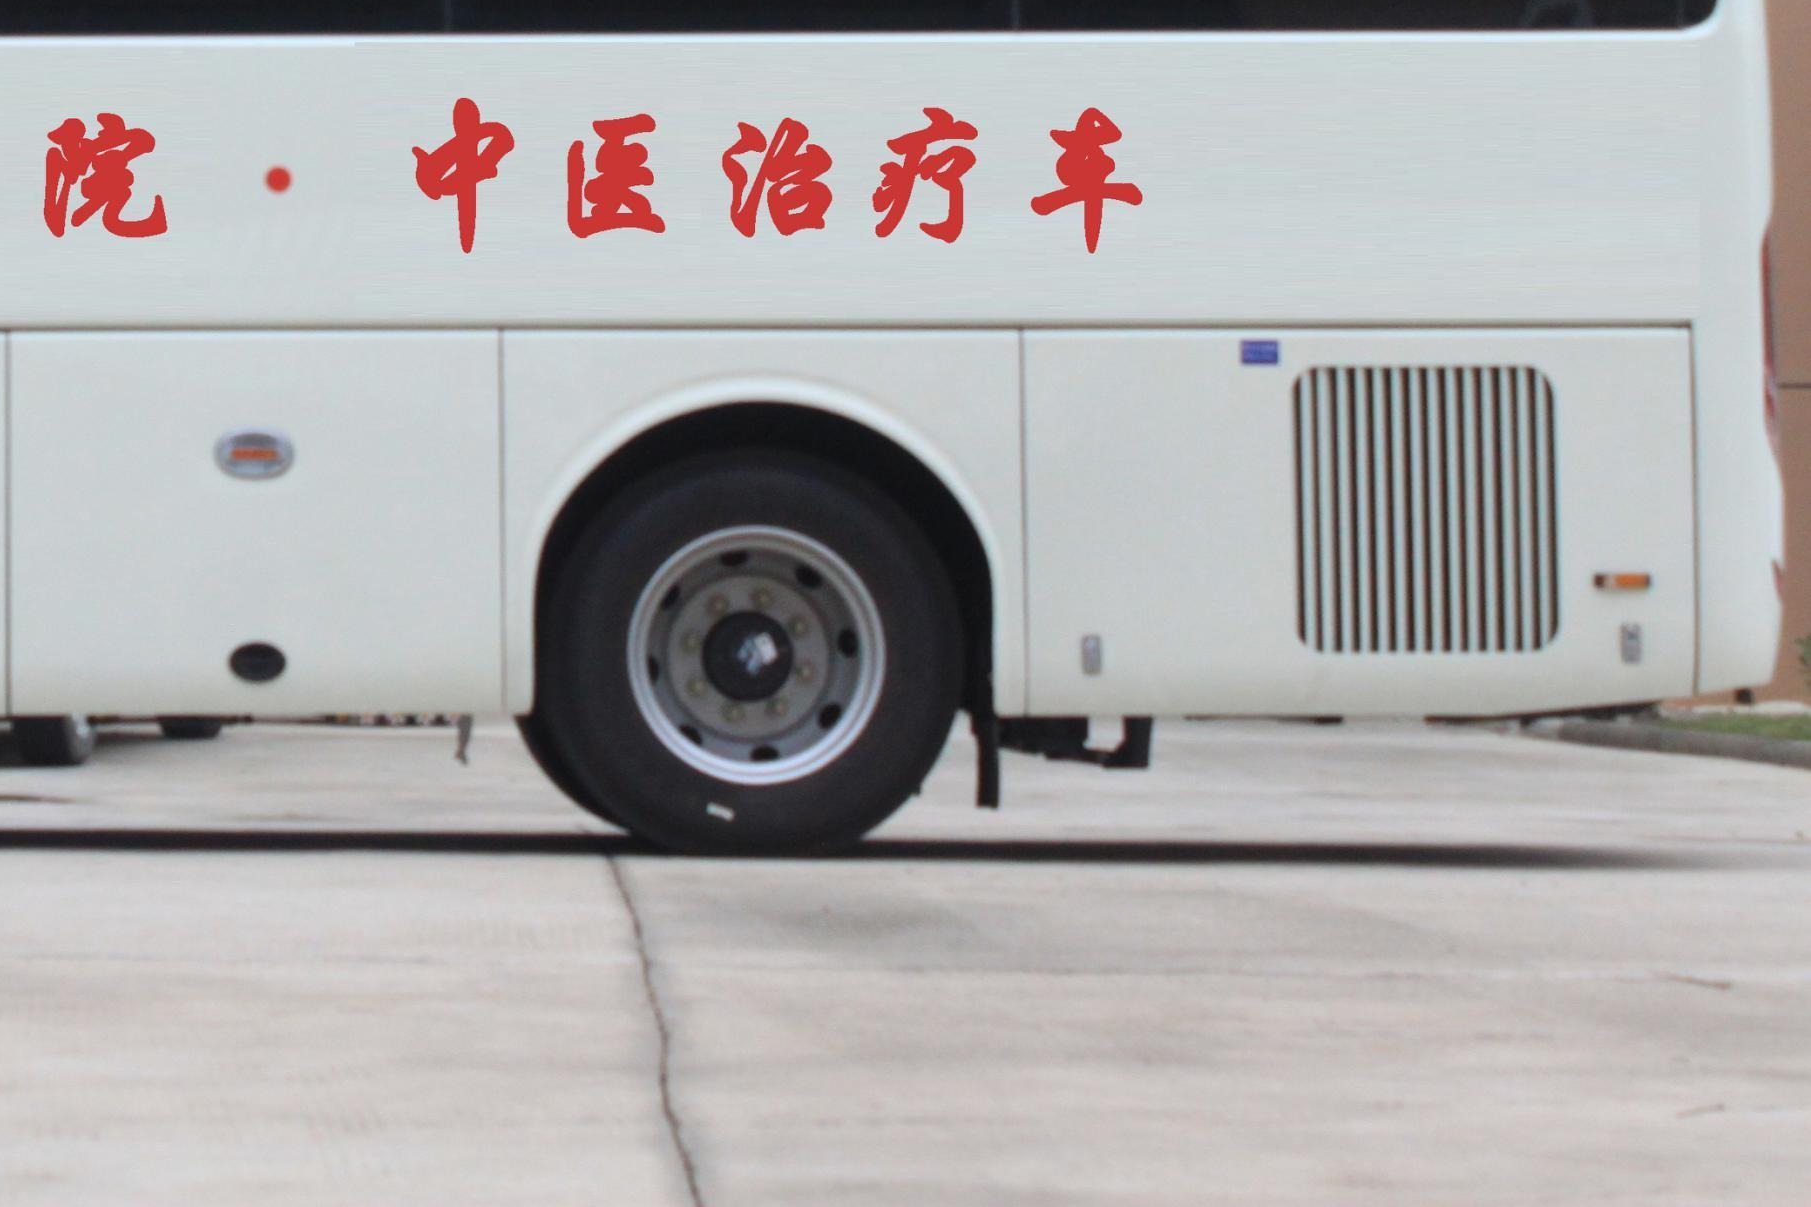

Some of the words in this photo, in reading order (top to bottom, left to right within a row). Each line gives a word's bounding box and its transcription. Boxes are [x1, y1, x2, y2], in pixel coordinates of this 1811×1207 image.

[411, 97, 1143, 254] 中医治疗车
